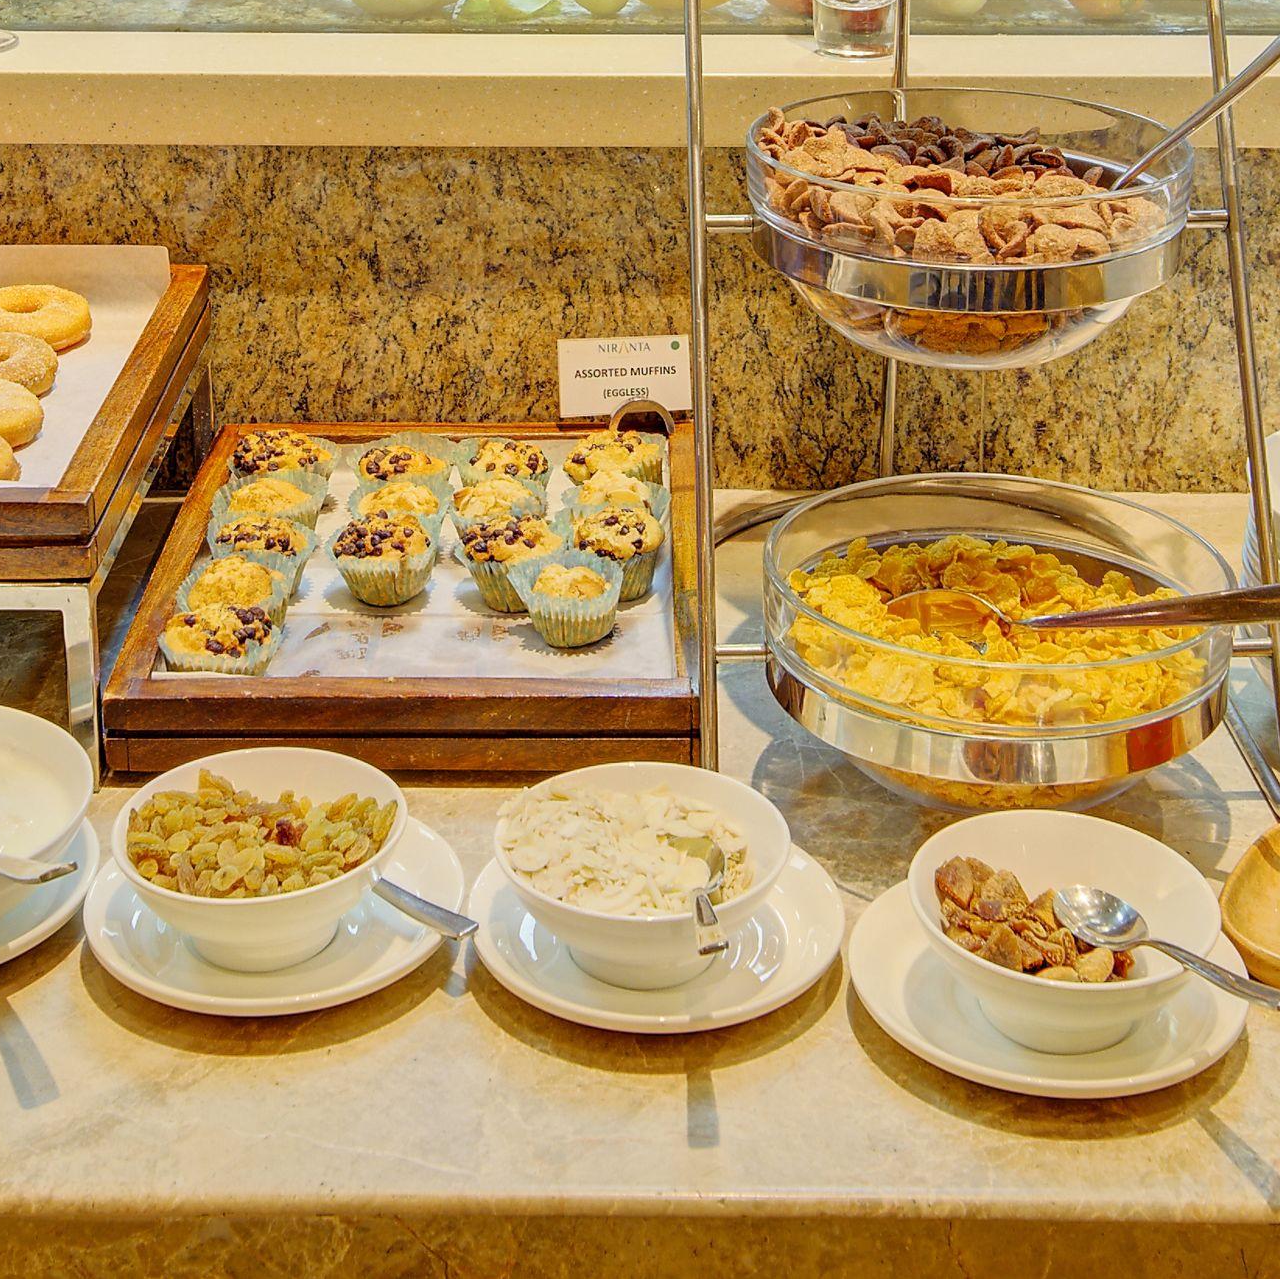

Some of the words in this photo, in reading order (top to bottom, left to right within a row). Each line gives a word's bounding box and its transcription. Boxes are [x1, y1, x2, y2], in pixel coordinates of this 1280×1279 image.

[598, 341, 651, 354] NIRANTA
[574, 367, 628, 379] ASSORTED
[630, 365, 677, 377] MUFFINS
[603, 387, 650, 399] (EGGLESS)
